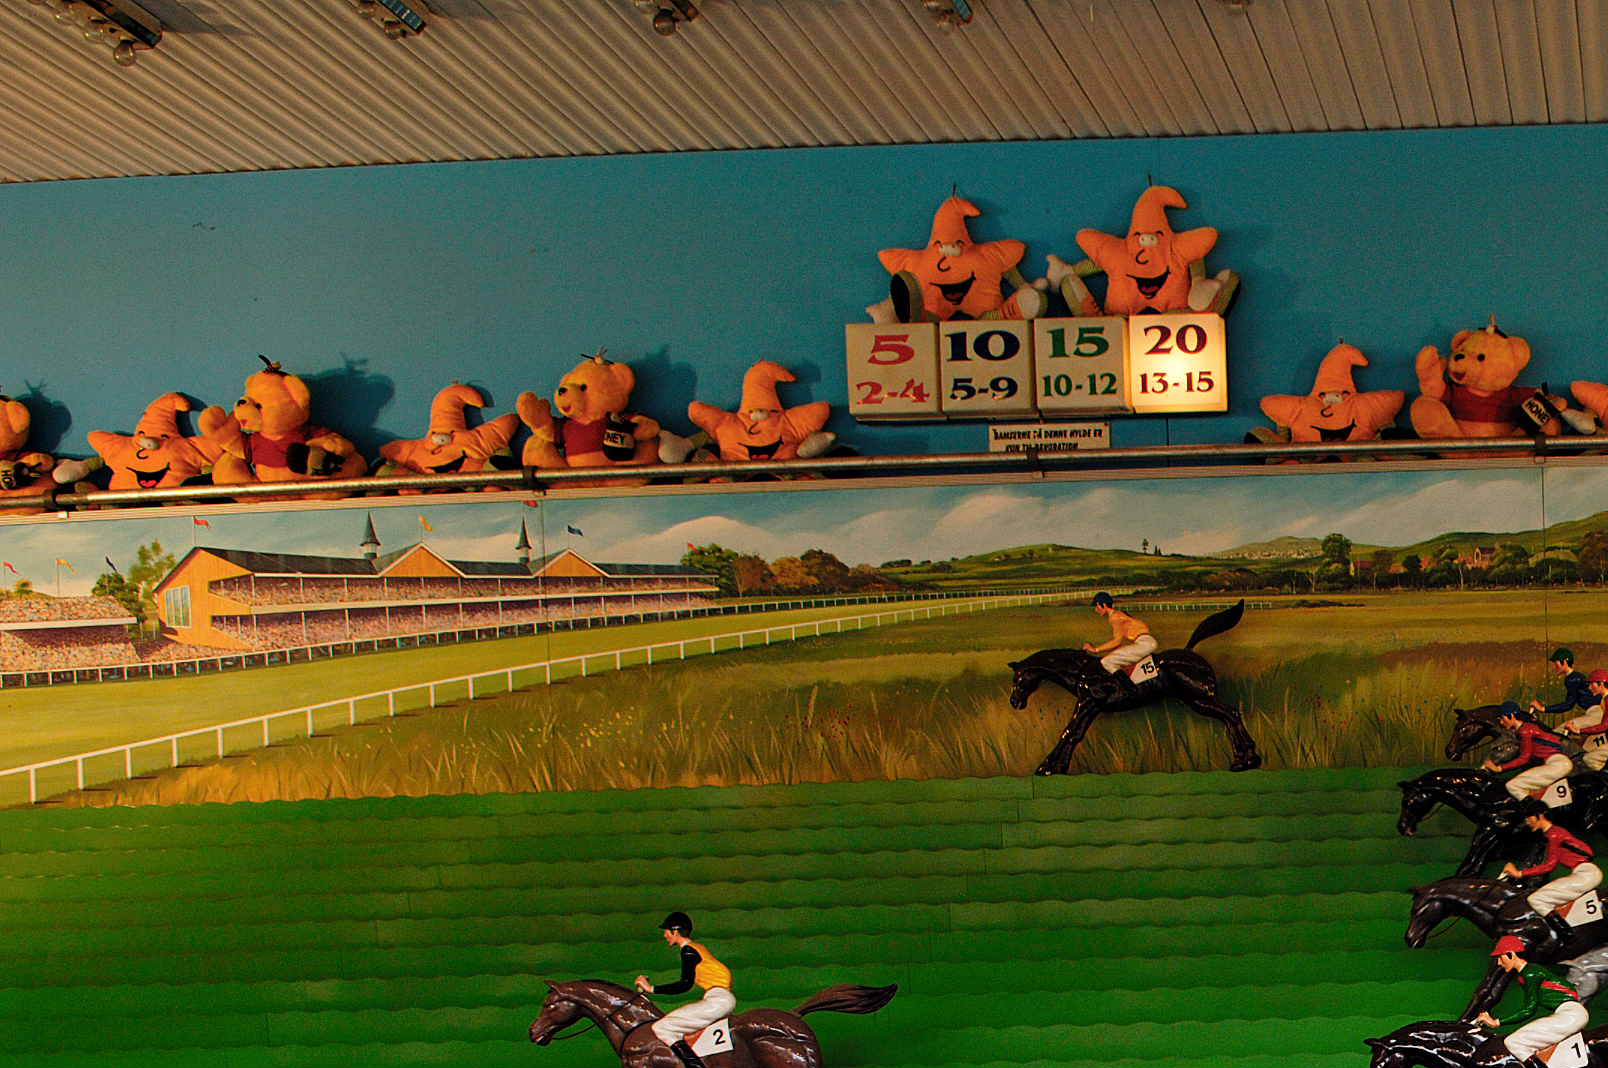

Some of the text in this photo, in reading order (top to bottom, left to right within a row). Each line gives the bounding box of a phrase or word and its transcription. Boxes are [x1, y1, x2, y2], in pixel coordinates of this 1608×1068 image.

[867, 334, 916, 366] 5
[945, 330, 1021, 362] 10
[1046, 326, 1110, 358] 15
[1143, 323, 1208, 355] 20
[856, 378, 930, 405] 2-4
[950, 376, 1018, 401] 5-9
[1042, 372, 1117, 397] 10-12
[1139, 371, 1215, 394] 13-15
[1140, 661, 1155, 675] 15
[1556, 785, 1567, 798] 9
[1585, 900, 1597, 914] 5
[713, 1029, 726, 1045] 2
[1571, 1042, 1581, 1058] 1
